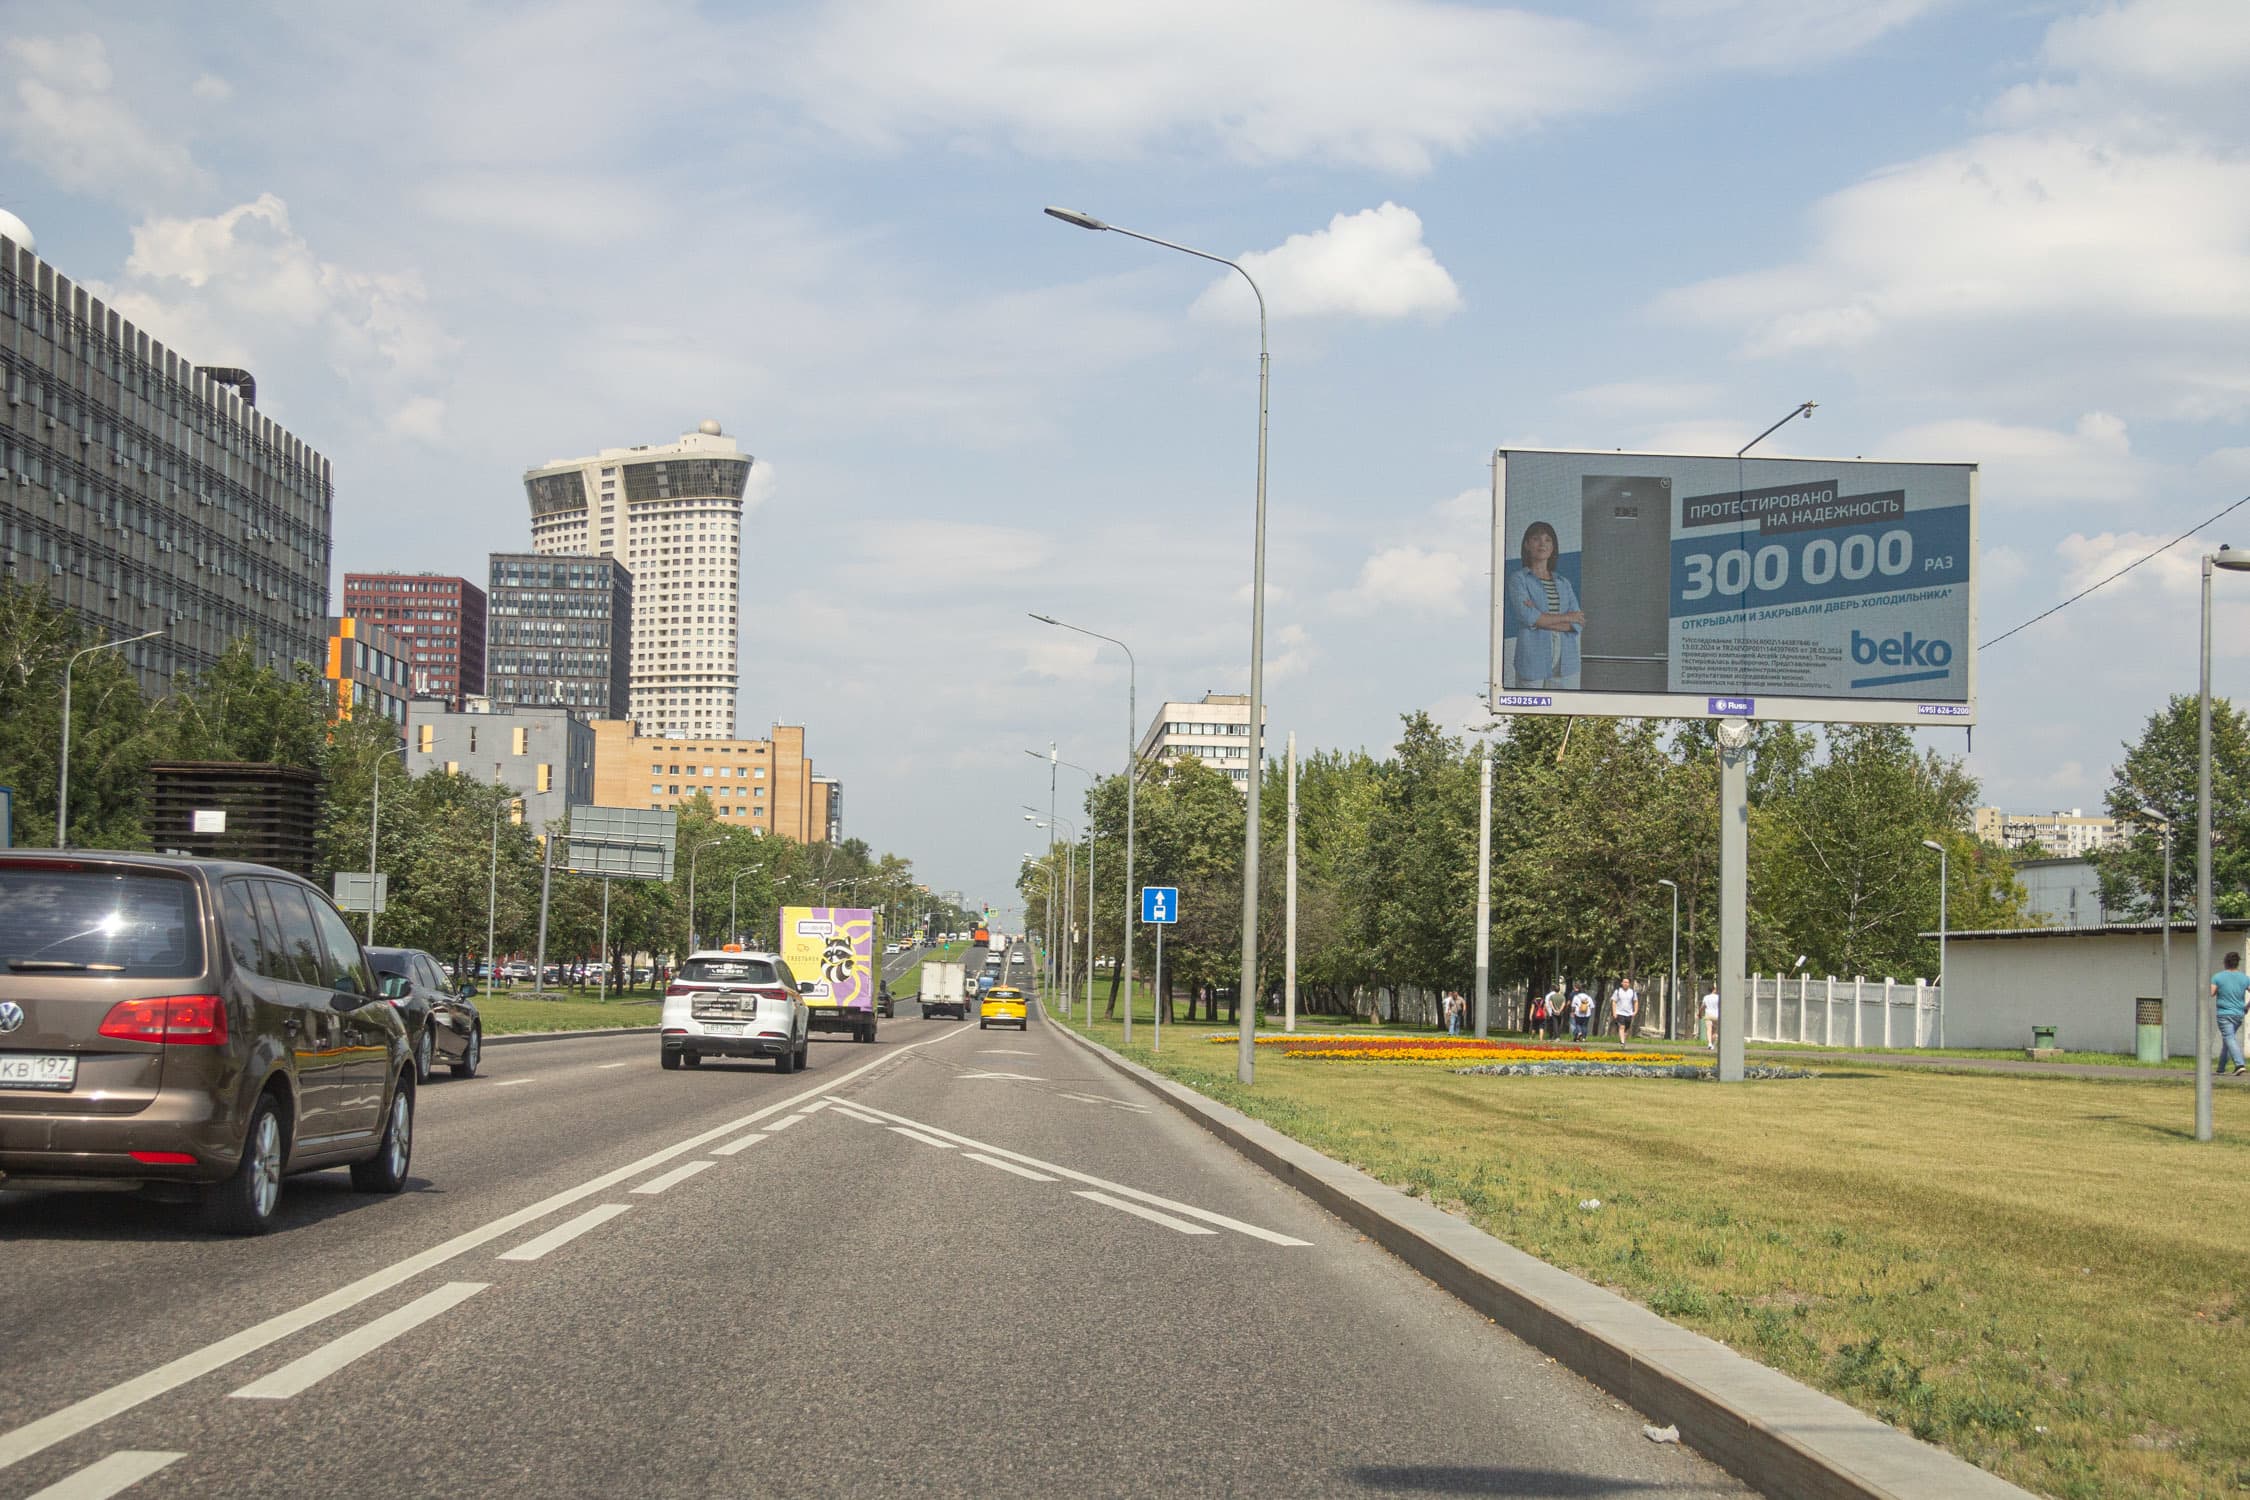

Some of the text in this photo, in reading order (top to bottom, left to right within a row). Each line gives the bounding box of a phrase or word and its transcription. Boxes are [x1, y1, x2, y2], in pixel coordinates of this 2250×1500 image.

[1690, 490, 1833, 519] ПРОТЕСТИРОВАНО
[1767, 499, 1899, 527] НА НАДЕЖНОСТЬ
[1682, 529, 1953, 601] 300 000 РАЗ
[1682, 613, 1746, 630] ОТКРЫВАЛИ
[1749, 611, 1757, 621] И
[1758, 604, 1822, 621] ЗАКРЫВАЛИ
[1824, 600, 1859, 613] ДВЕРЬ
[1851, 630, 1953, 667] beko
[1500, 697, 1538, 705] MS30254
[1728, 702, 1748, 710] Russ
[37, 1057, 68, 1073] 197
